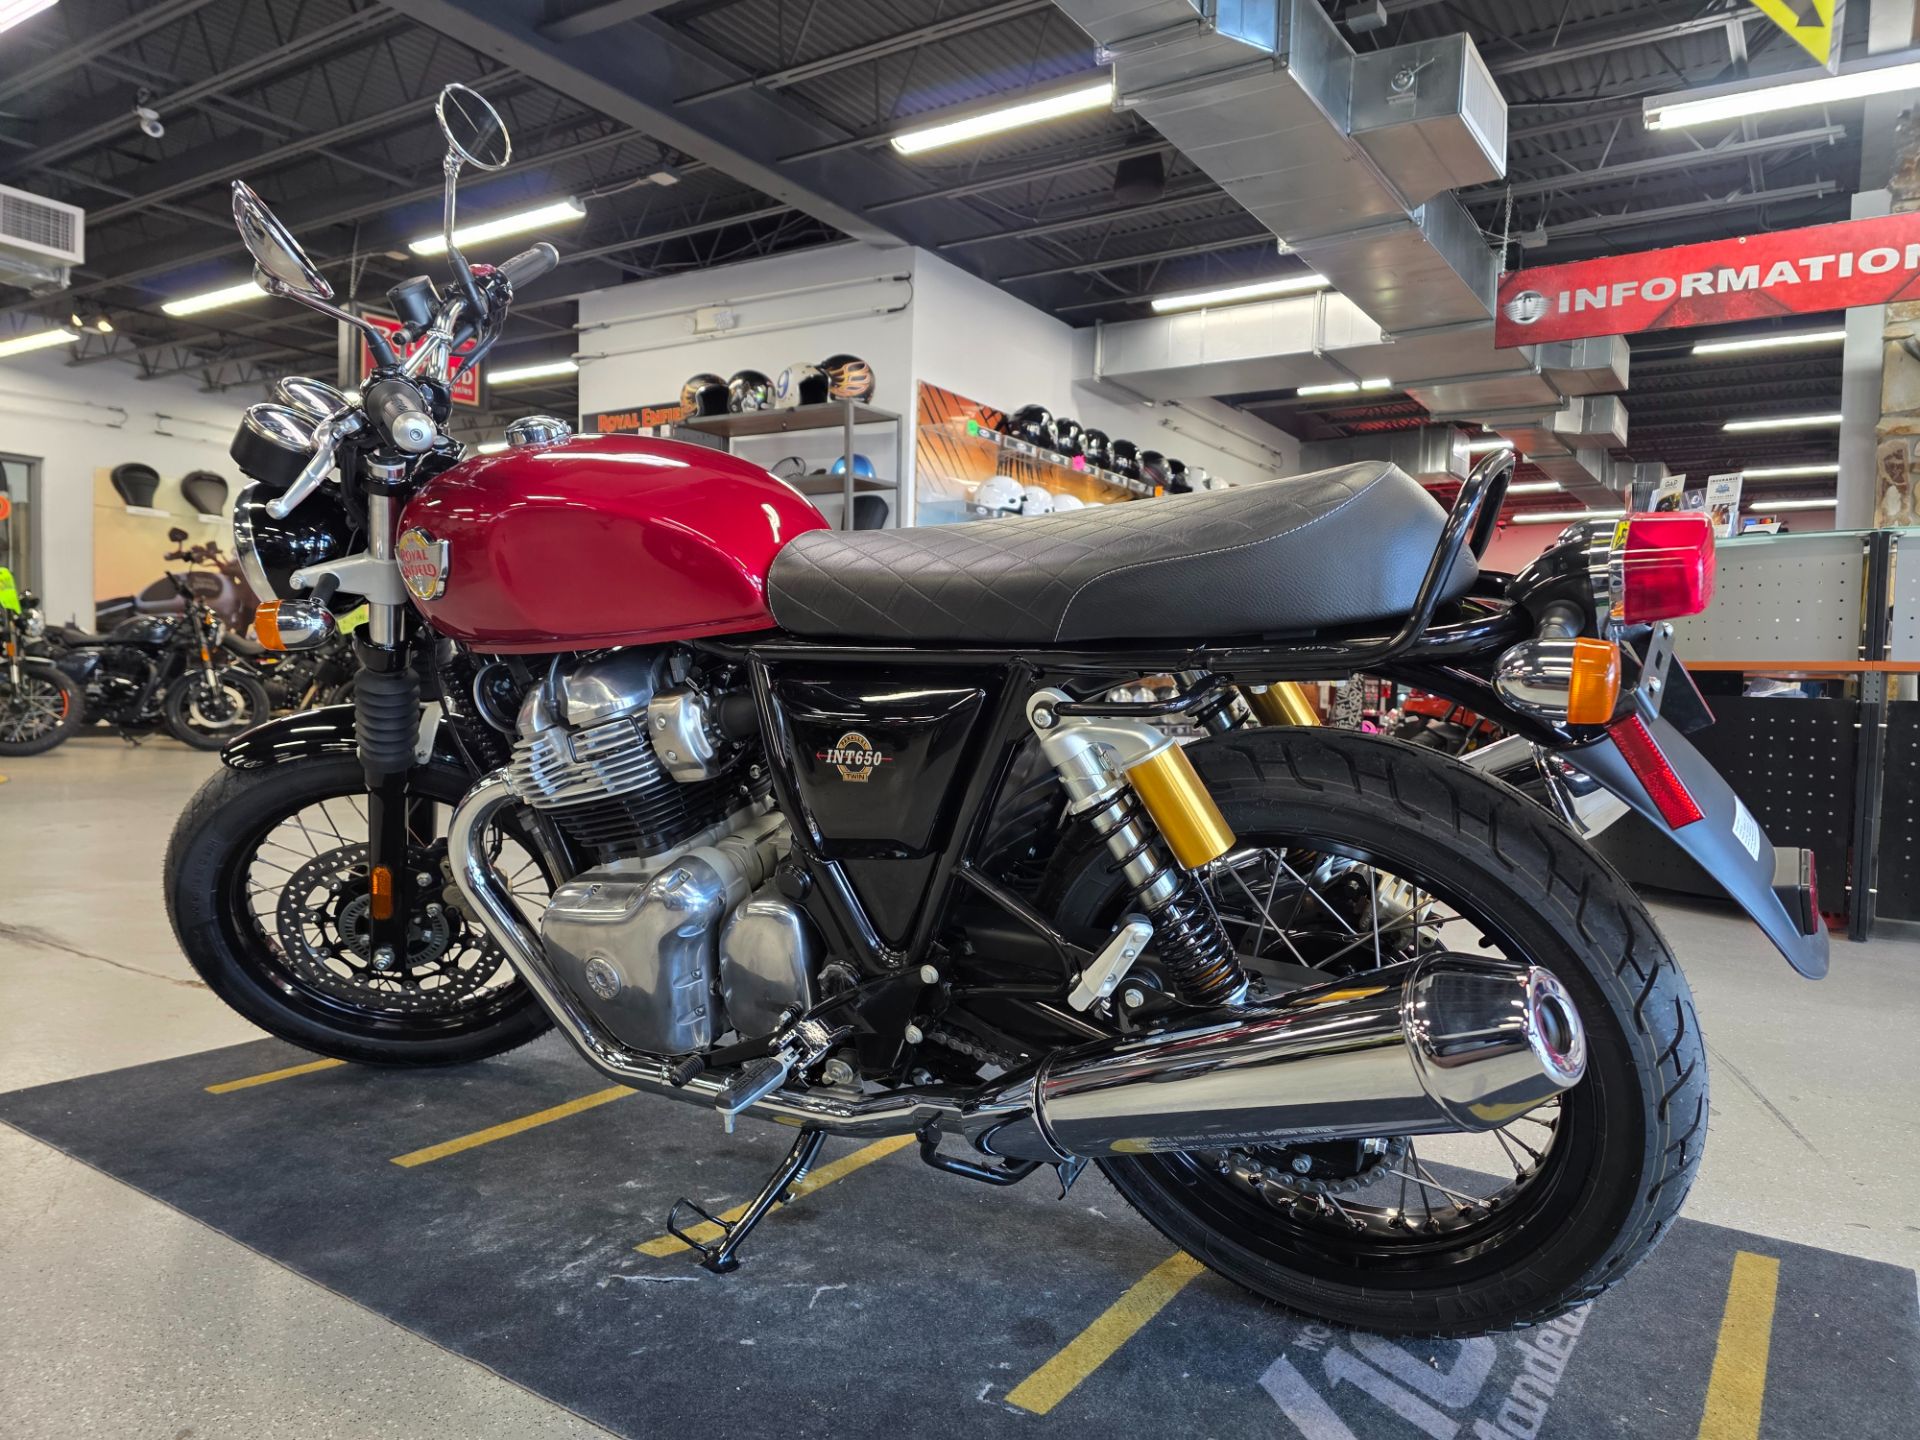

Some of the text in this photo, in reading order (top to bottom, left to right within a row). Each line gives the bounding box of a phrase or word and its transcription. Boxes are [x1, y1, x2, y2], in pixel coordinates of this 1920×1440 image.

[598, 412, 640, 432] ROYAL
[400, 549, 429, 562] ROYAL
[825, 749, 882, 766] INT650
